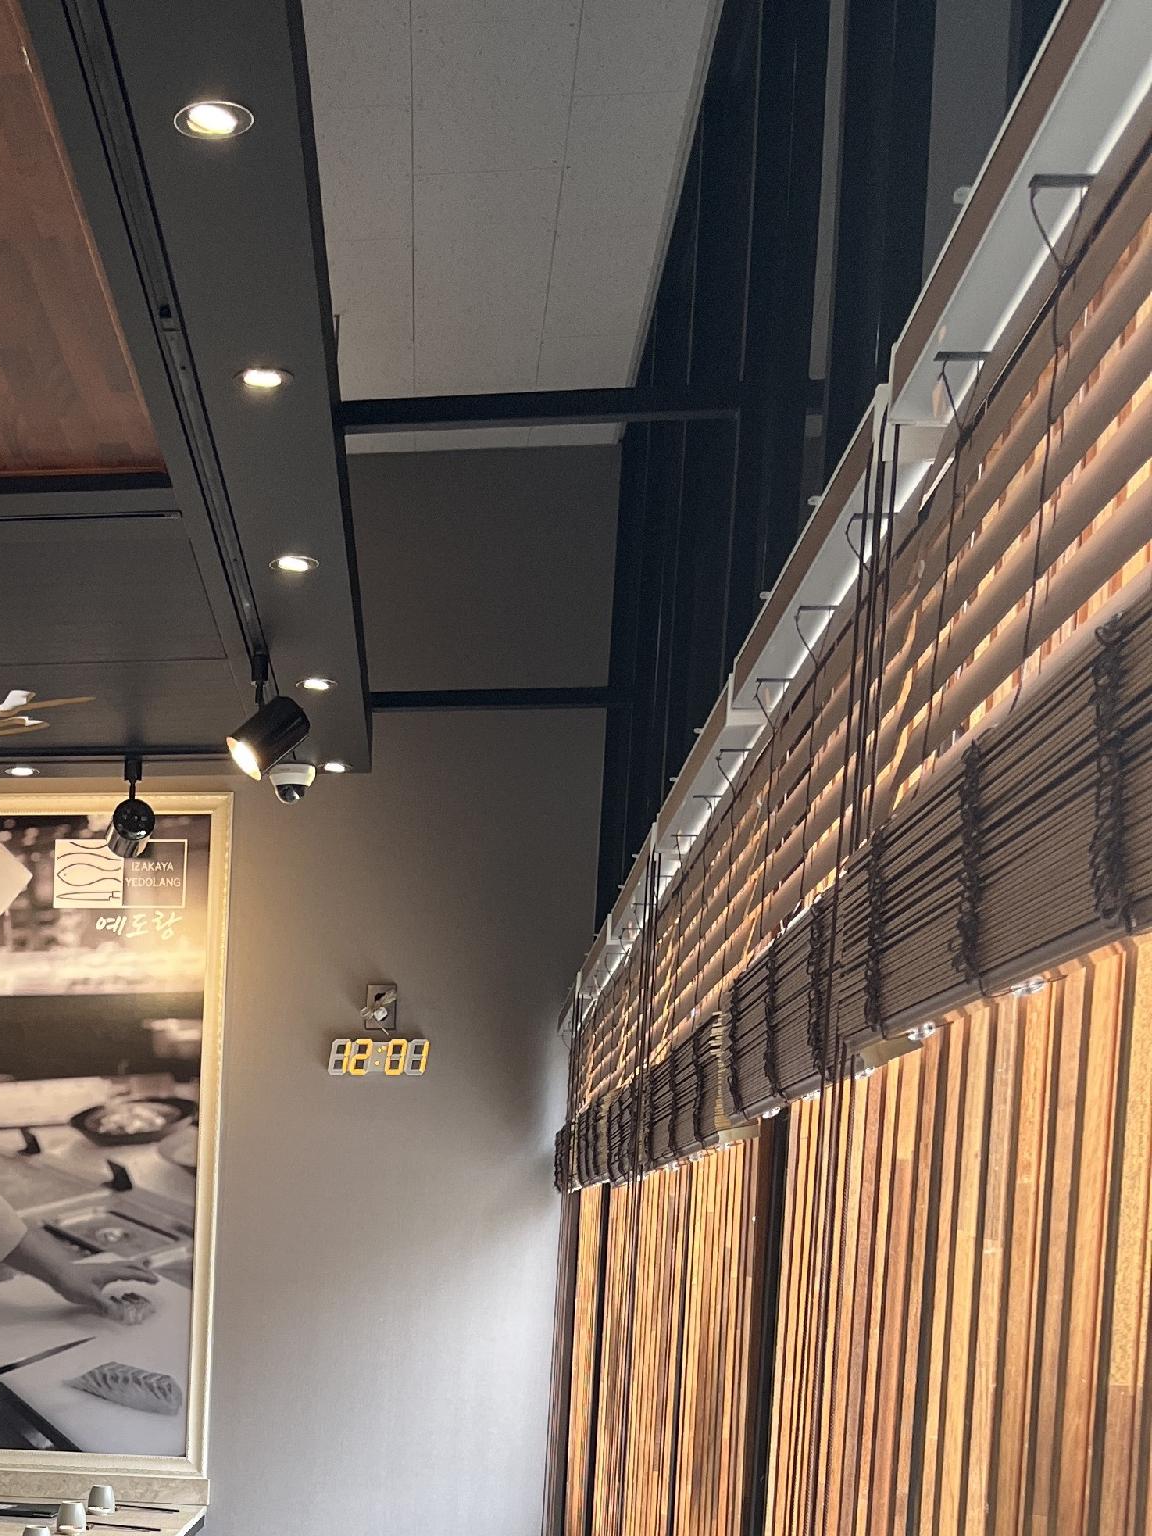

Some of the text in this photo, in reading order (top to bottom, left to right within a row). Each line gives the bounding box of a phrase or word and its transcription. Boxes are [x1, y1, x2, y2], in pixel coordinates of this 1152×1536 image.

[131, 861, 174, 872] IZAKAYA
[125, 877, 182, 888] YEDOLANG
[95, 910, 183, 940] 예도랑
[336, 1038, 430, 1076] 12:01
